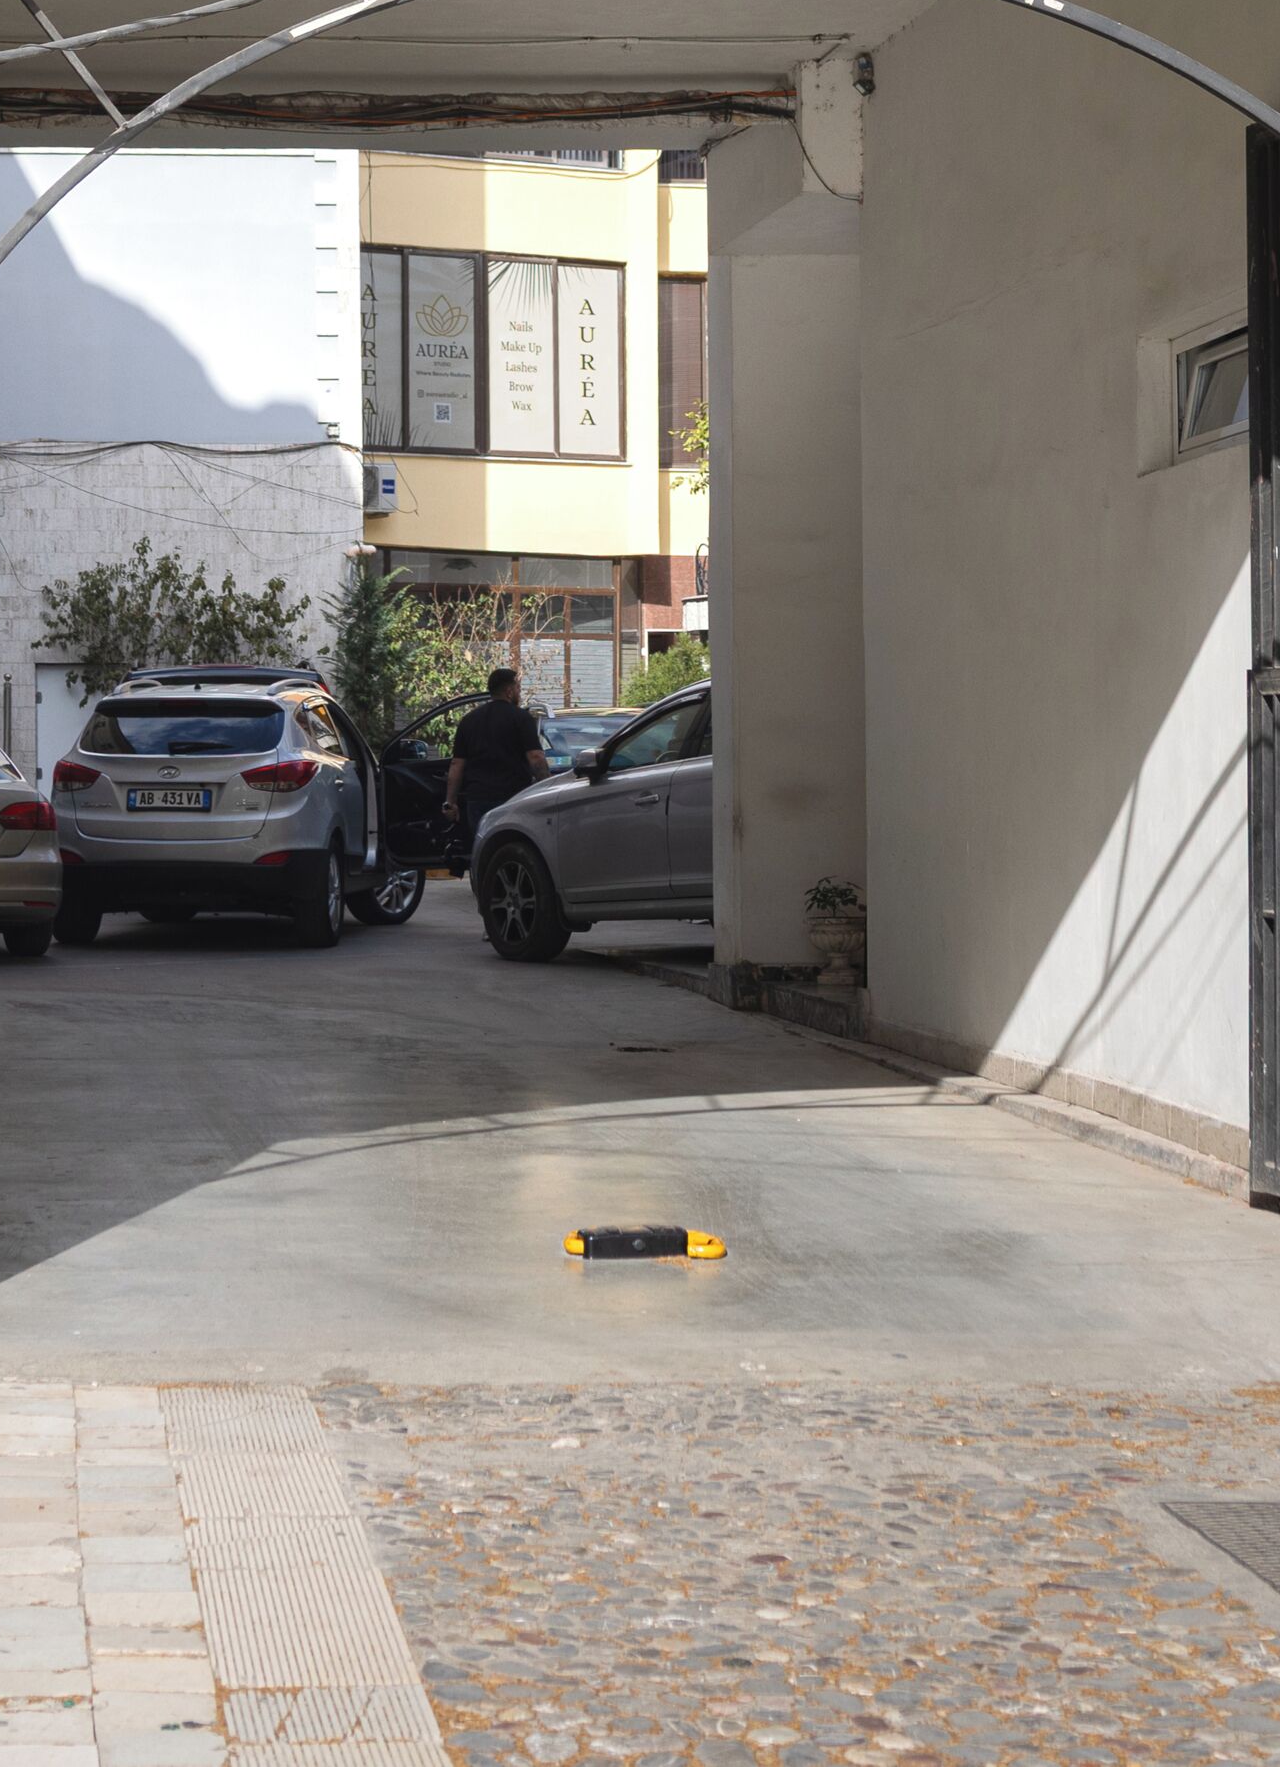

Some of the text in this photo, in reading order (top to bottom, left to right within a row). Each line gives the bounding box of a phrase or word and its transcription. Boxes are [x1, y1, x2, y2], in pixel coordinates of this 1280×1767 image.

[509, 321, 533, 332] Nails
[415, 341, 469, 359] AURÉA
[500, 341, 542, 356] Make Up
[505, 361, 538, 373] Lashes
[579, 298, 596, 426] AURÉA
[509, 381, 533, 392] Brow
[512, 400, 532, 411] Wax
[139, 792, 154, 805] AB
